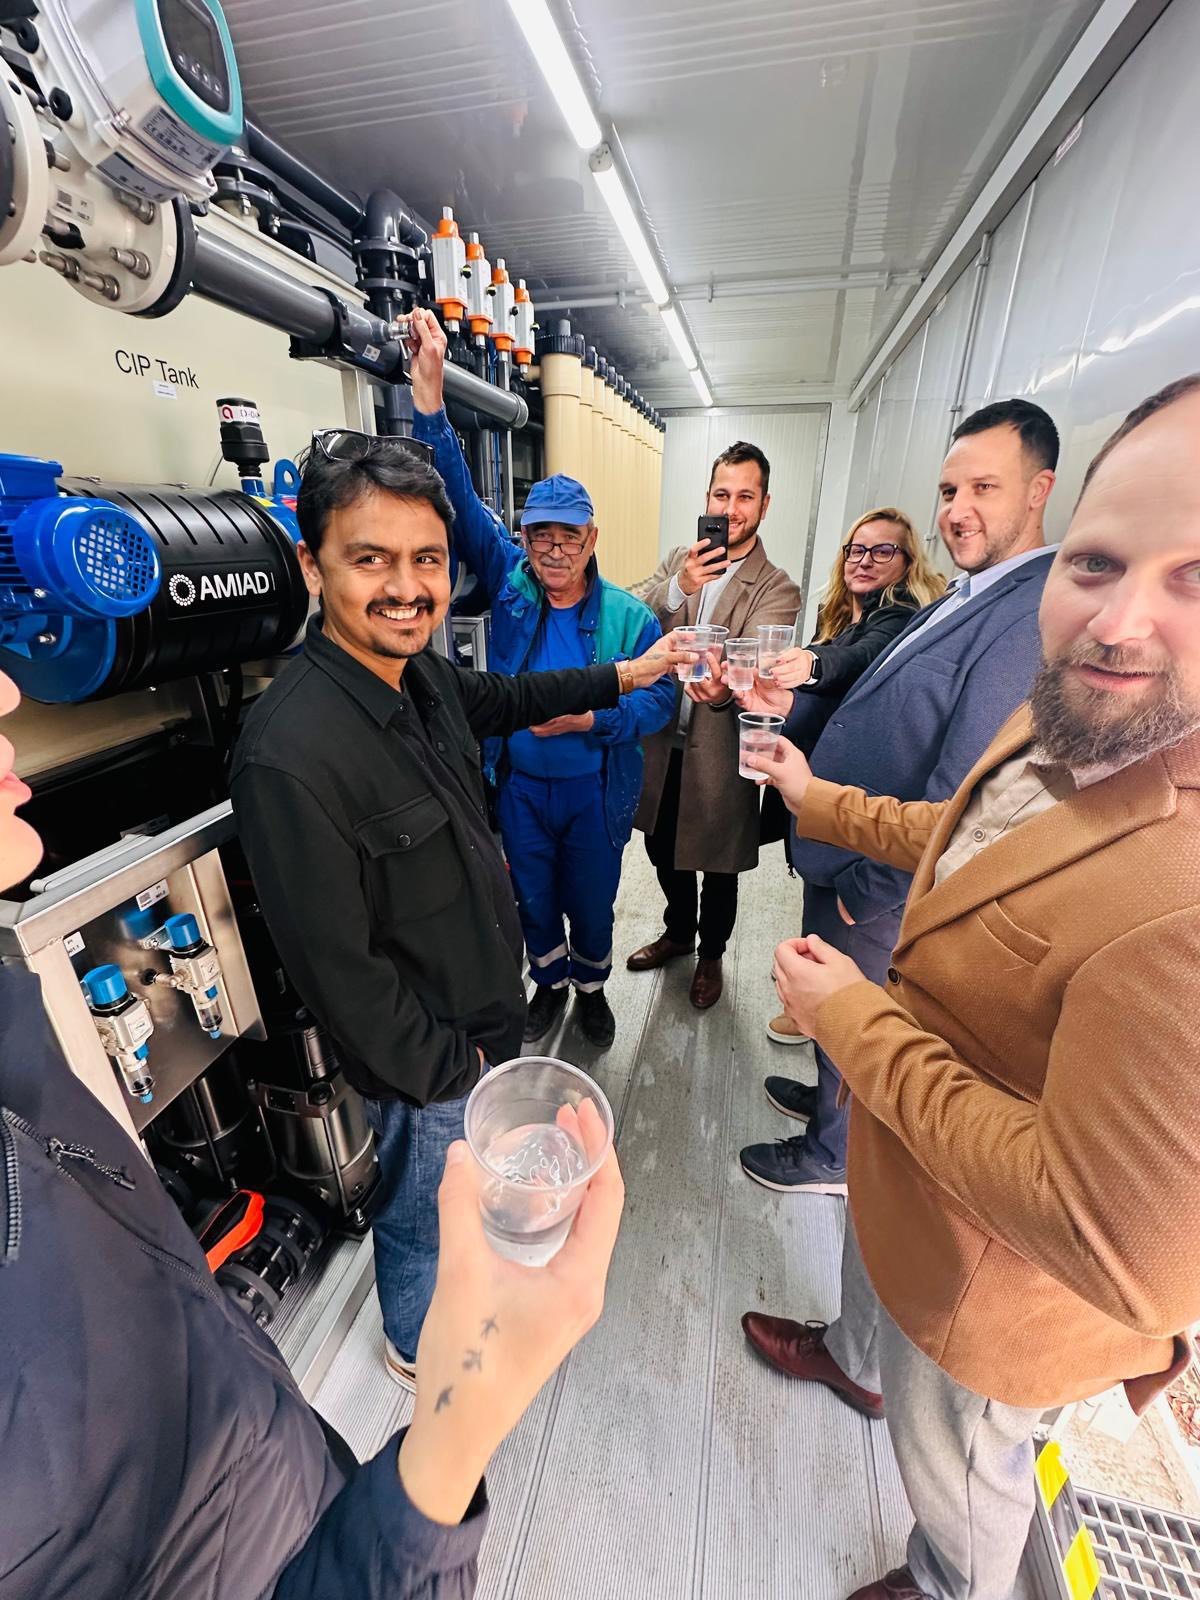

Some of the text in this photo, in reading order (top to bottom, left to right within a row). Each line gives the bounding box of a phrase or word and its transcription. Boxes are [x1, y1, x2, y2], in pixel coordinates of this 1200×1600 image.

[115, 349, 200, 389] CIP Tank
[200, 571, 270, 601] AMIAD
